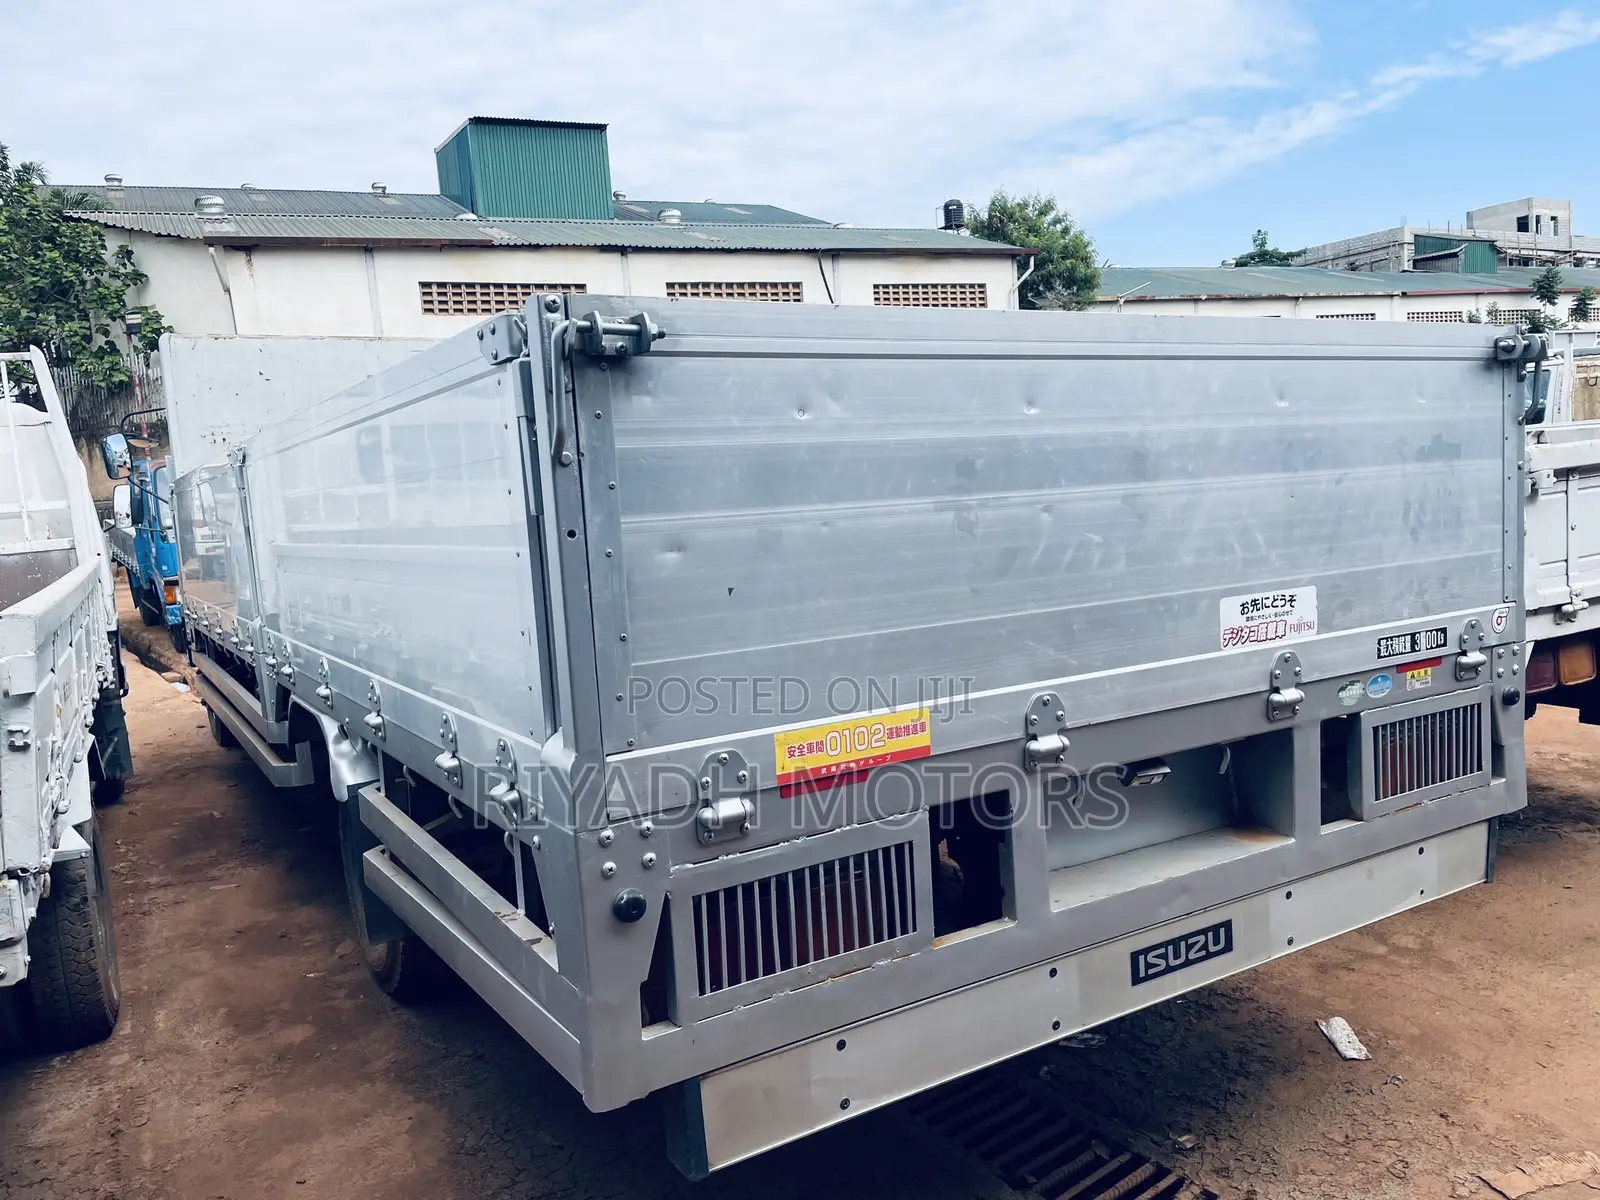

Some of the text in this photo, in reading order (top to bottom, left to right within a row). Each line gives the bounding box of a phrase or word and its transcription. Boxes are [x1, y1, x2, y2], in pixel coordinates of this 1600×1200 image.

[1240, 594, 1297, 616] お先にどうぞ
[1289, 616, 1315, 635] FUJITSU
[1138, 927, 1225, 978] ISUZU
